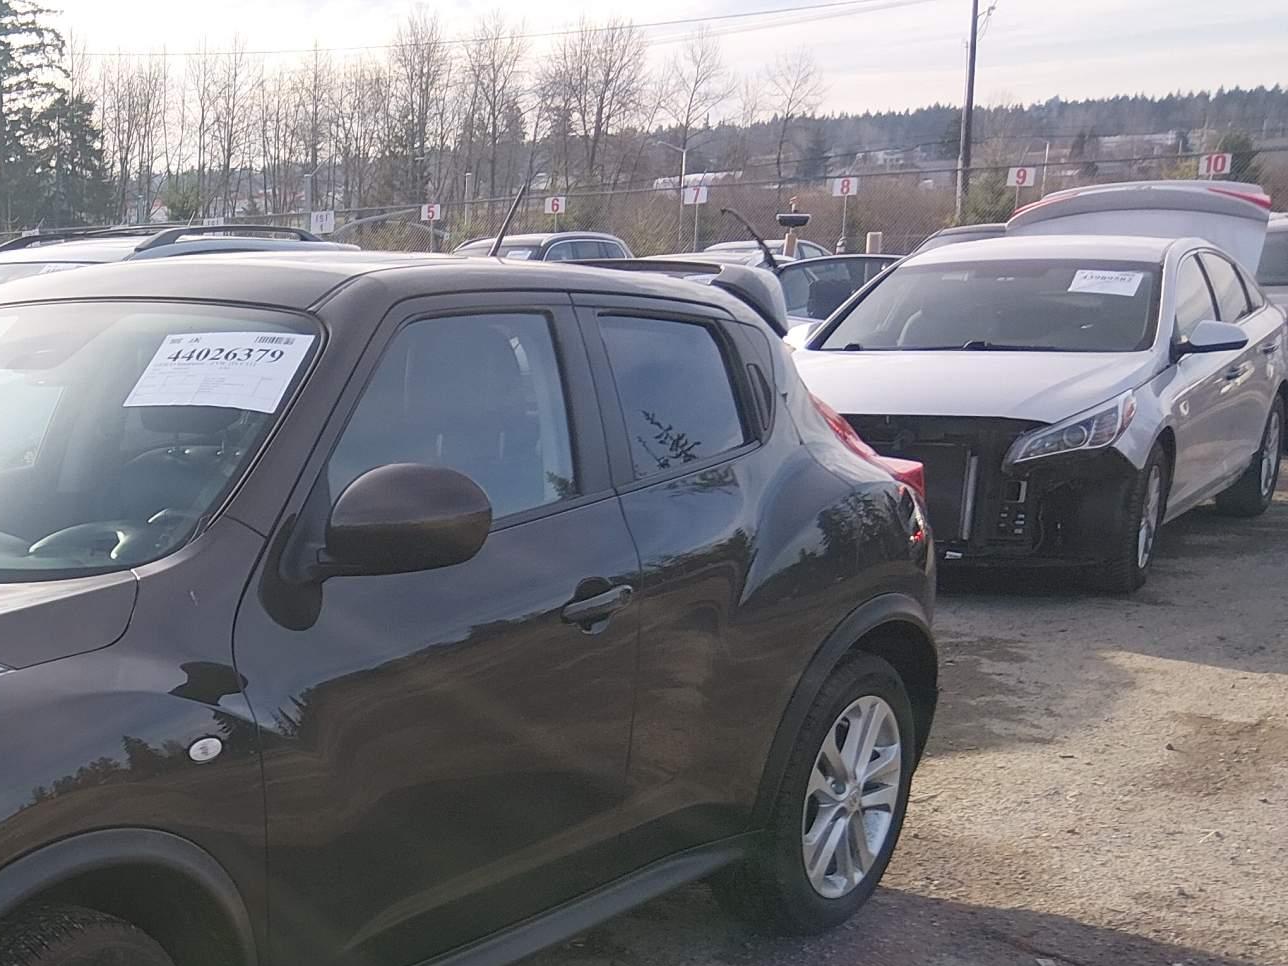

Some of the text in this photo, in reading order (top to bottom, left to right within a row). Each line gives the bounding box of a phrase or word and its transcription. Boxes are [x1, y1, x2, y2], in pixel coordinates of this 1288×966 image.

[1205, 154, 1226, 173] 10
[1016, 168, 1027, 184] 9
[840, 178, 850, 194] 8
[693, 187, 701, 203] 7
[427, 205, 435, 219] 5
[551, 198, 559, 212] 6
[168, 347, 284, 362] 44026379
